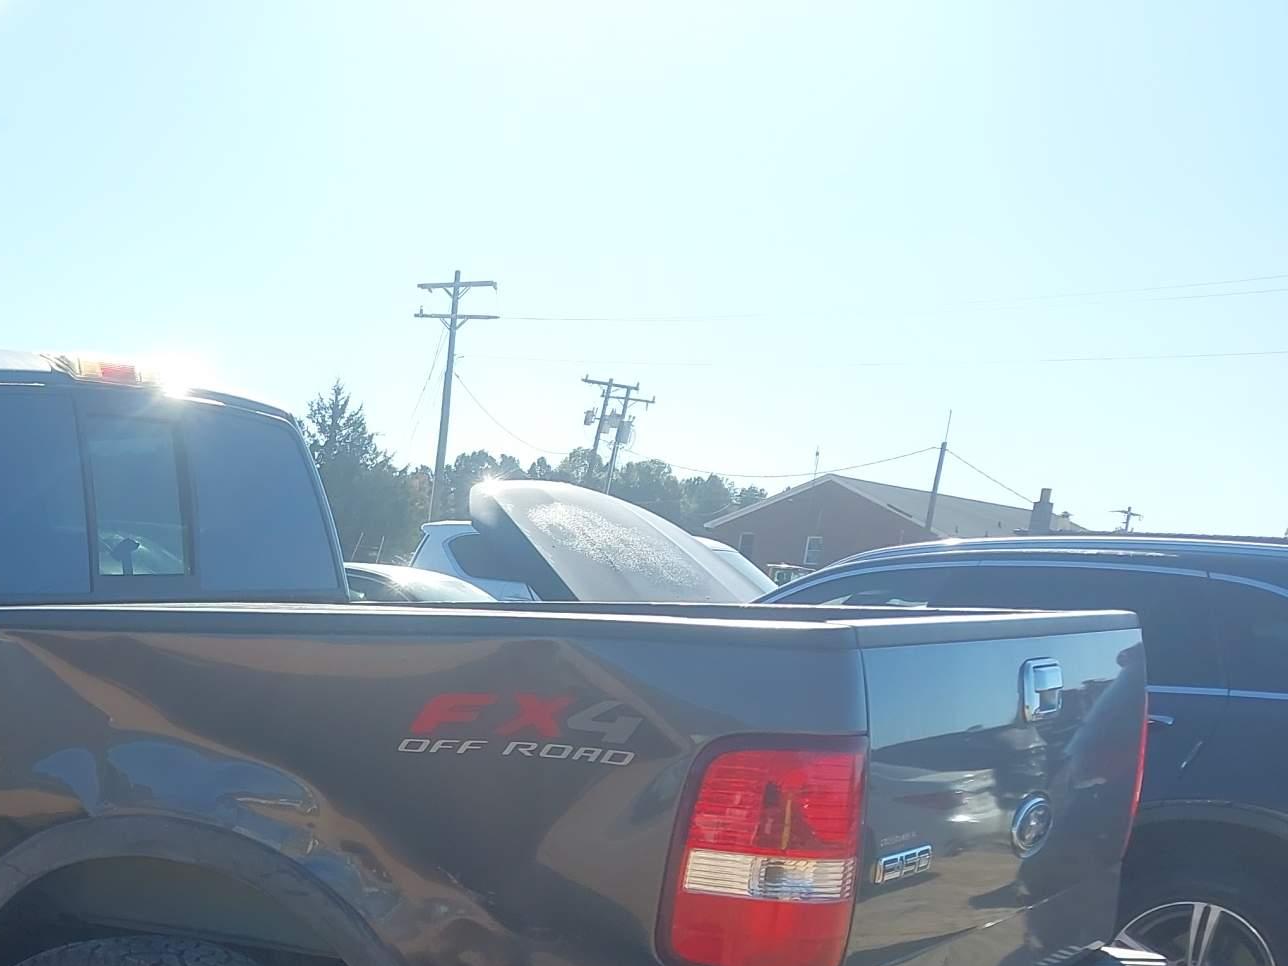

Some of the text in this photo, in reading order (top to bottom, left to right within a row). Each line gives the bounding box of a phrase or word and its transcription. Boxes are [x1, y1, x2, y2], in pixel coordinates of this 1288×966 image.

[410, 692, 643, 744] FX4
[398, 738, 635, 766] OFF ROAD
